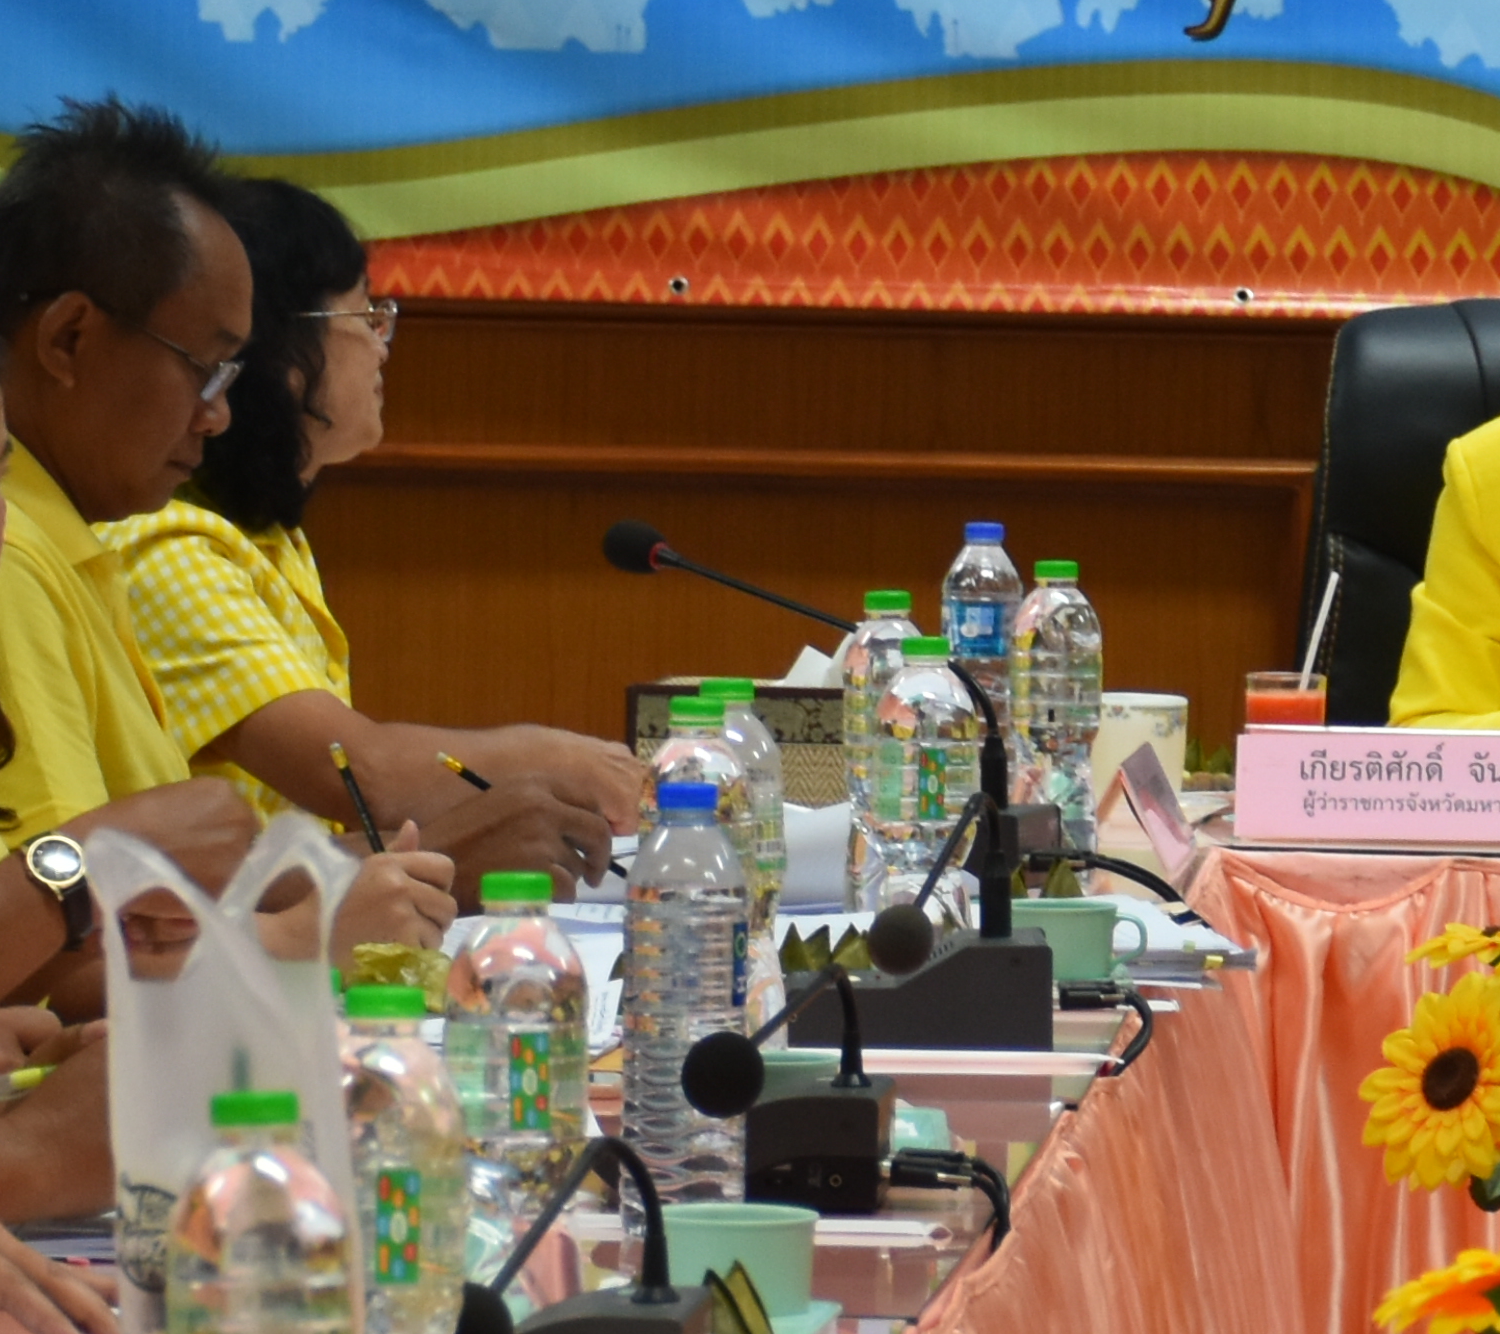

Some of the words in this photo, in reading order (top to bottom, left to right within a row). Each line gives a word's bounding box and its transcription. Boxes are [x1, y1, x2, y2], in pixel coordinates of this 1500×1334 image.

[1299, 742, 1445, 783] เกียรติศักดิ์
